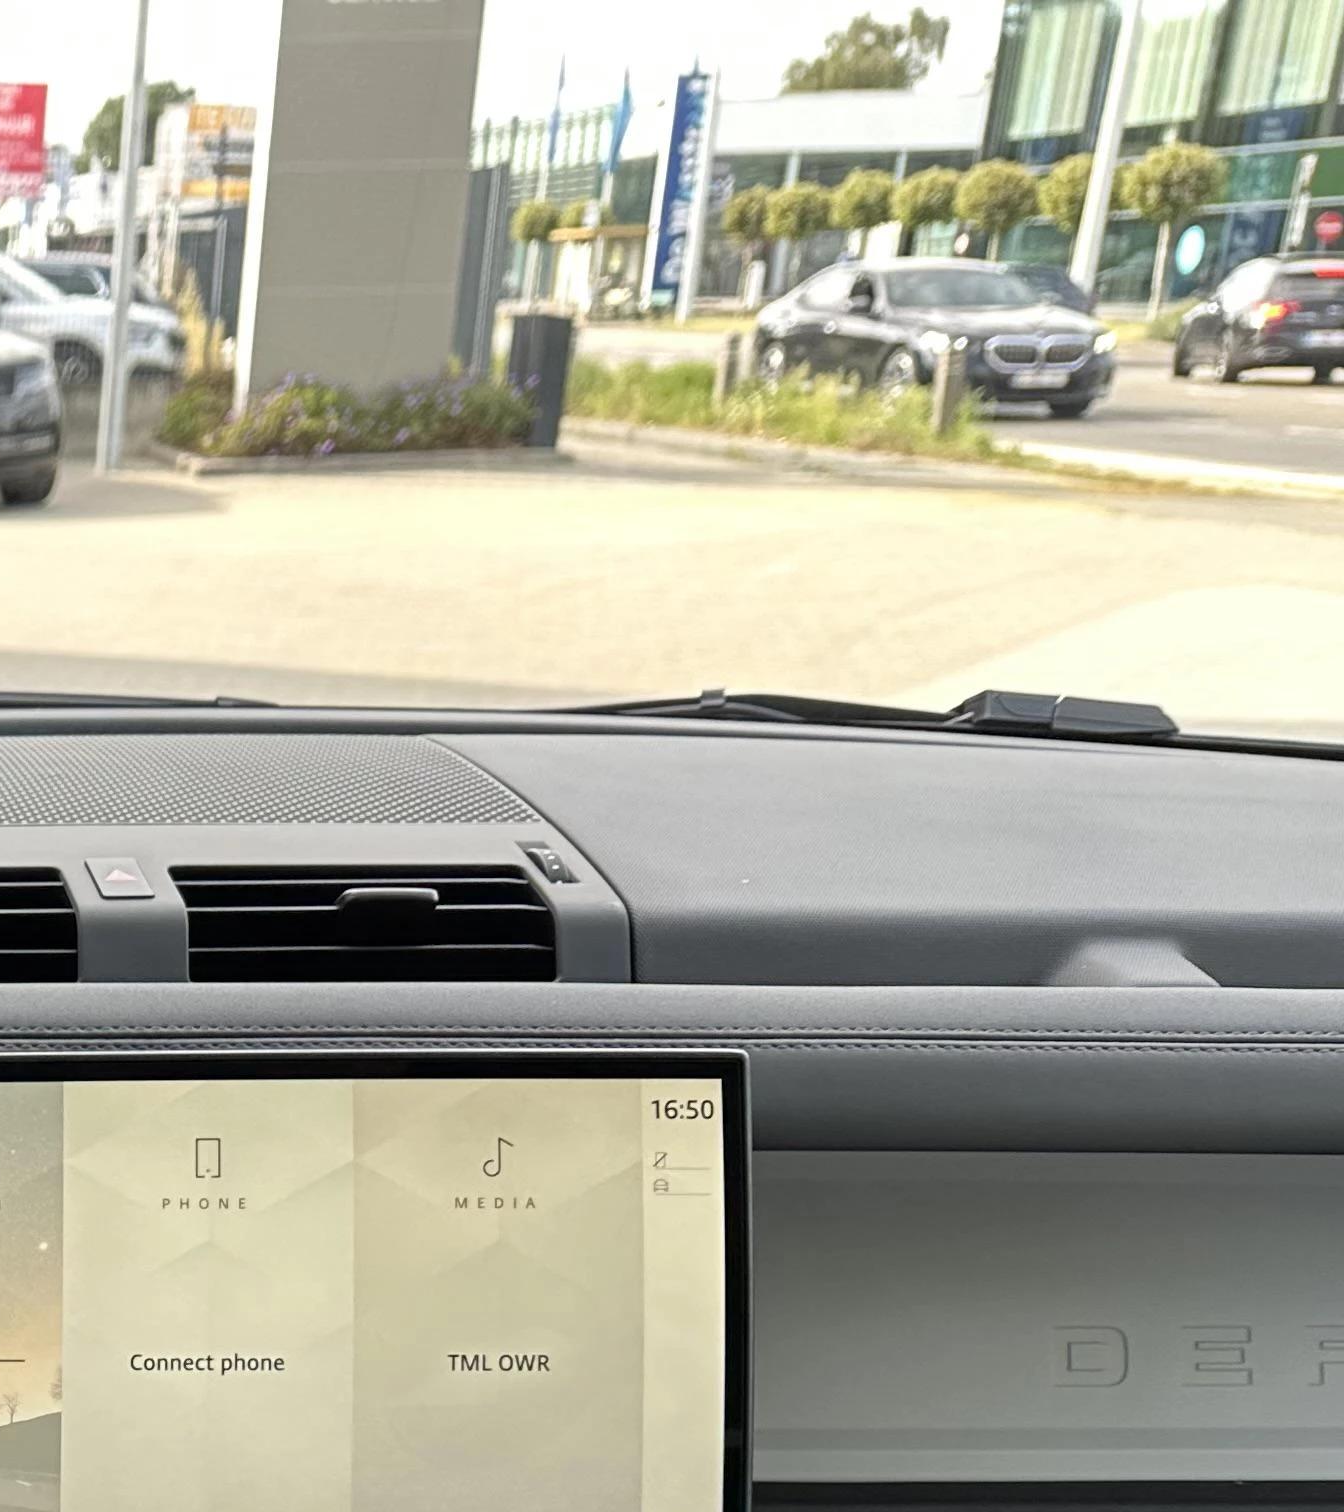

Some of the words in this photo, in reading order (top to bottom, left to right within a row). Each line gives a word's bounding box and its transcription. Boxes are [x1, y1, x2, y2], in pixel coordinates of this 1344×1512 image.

[651, 1100, 714, 1121] 16:50
[162, 1197, 248, 1210] PHONE
[454, 1197, 537, 1210] MEDIA
[130, 1353, 213, 1372] Connect
[220, 1353, 286, 1376] phone
[448, 1354, 492, 1372] TML
[498, 1354, 550, 1372] OWR
